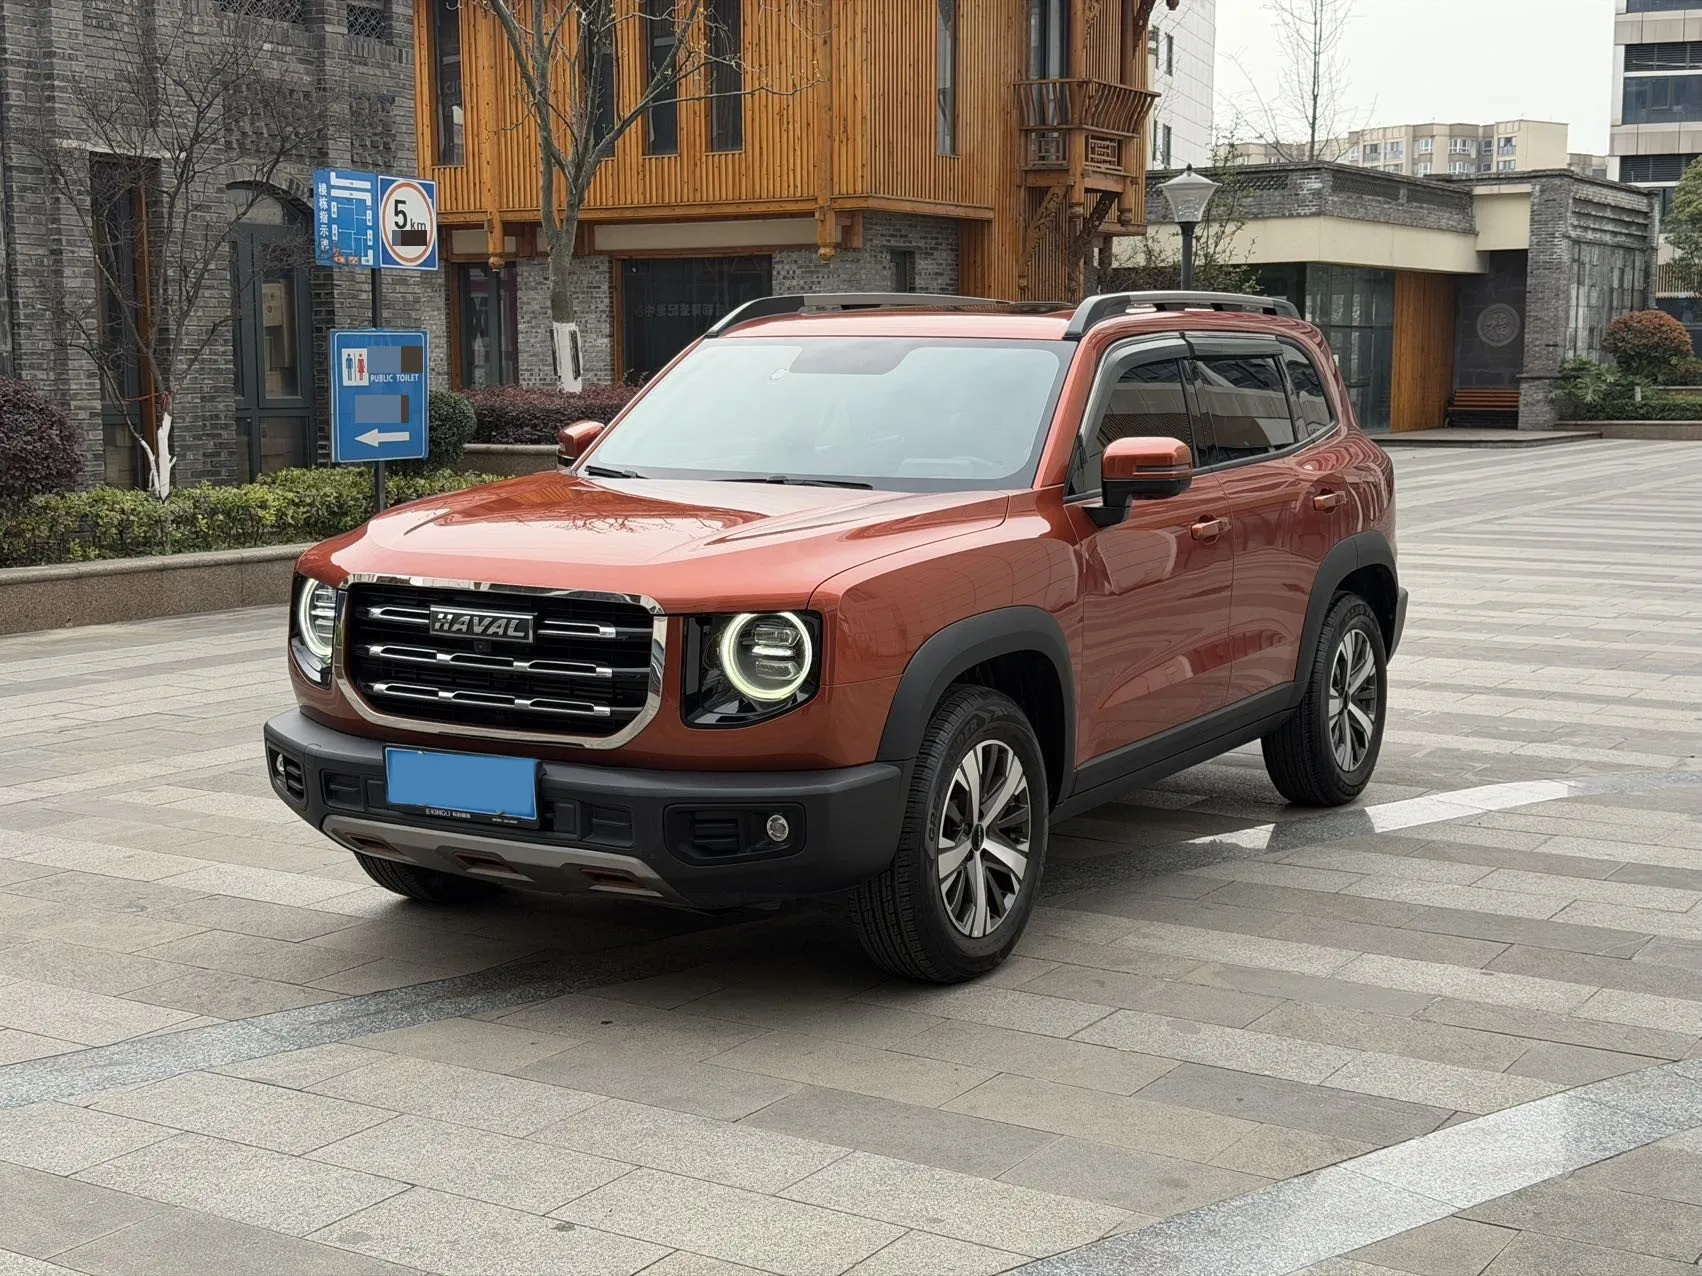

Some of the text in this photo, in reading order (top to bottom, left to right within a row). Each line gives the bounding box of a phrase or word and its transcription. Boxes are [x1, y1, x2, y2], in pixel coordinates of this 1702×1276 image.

[370, 373, 420, 383] PUBLIC TOILET
[434, 613, 525, 637] HAVAL
